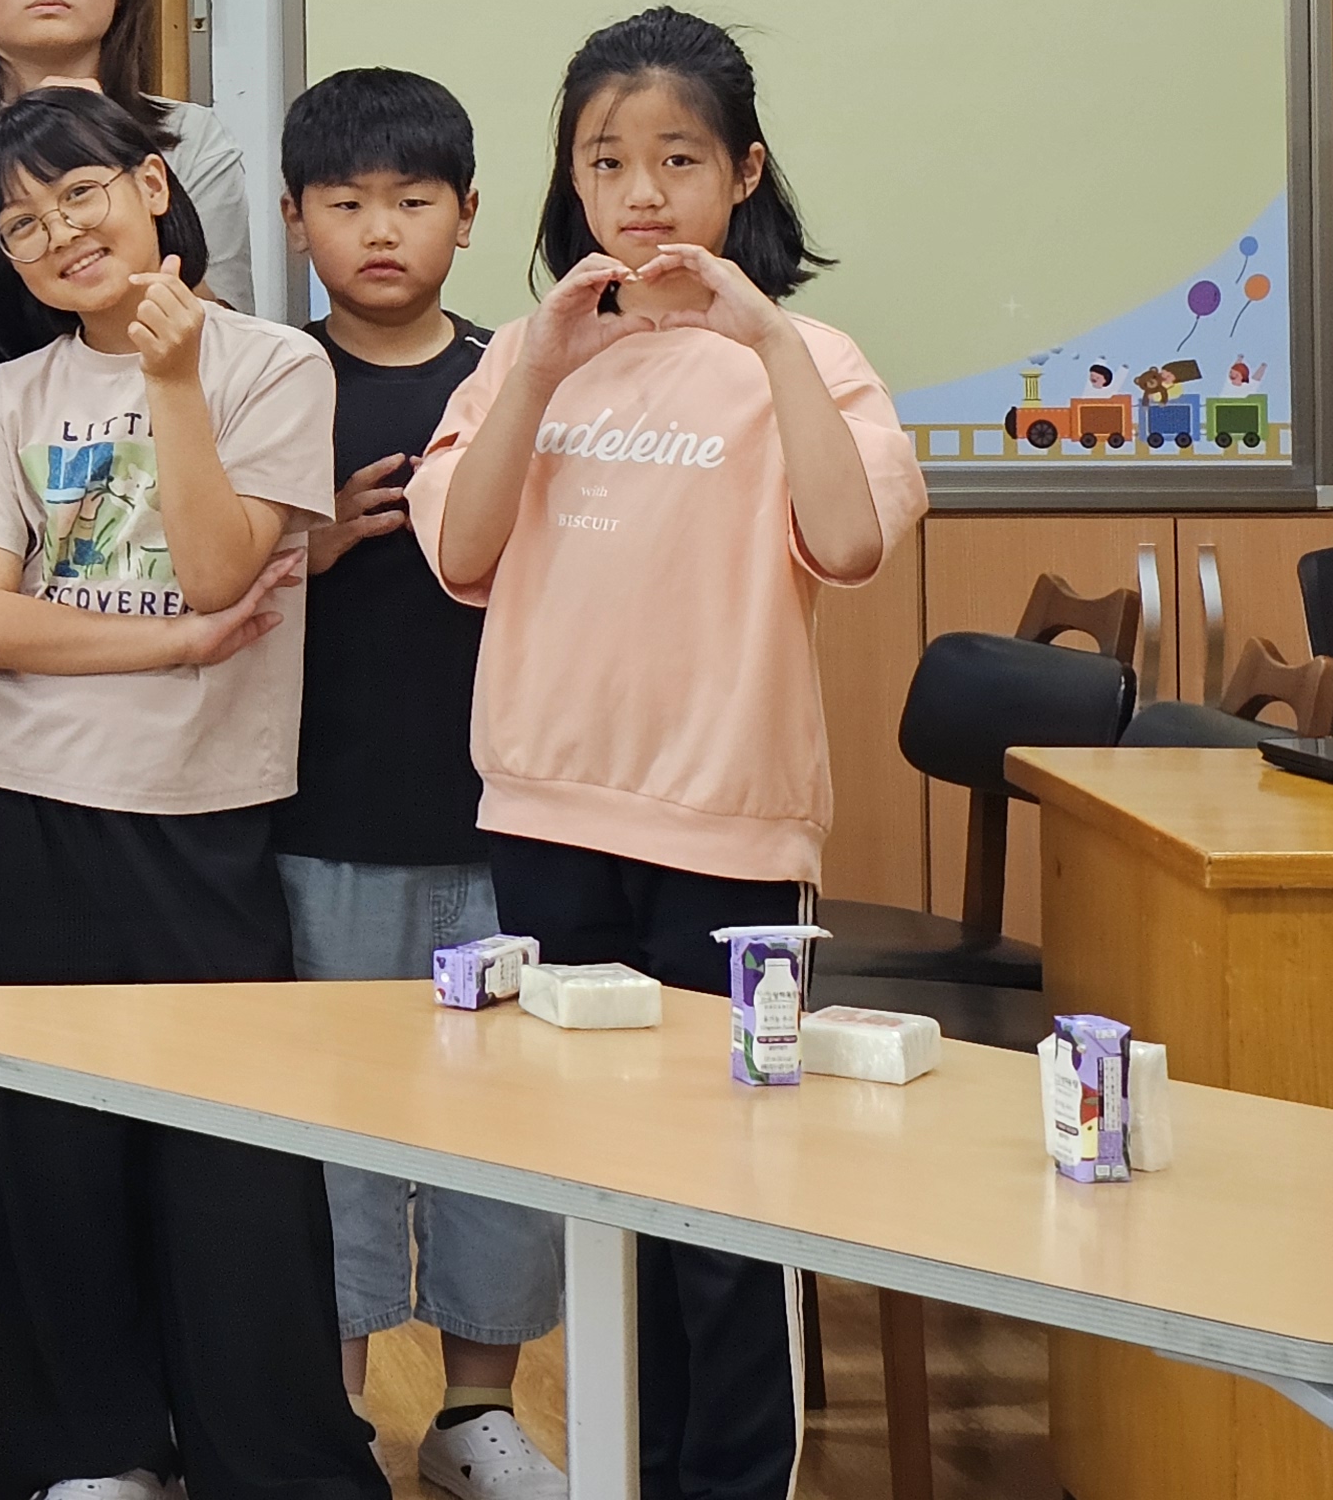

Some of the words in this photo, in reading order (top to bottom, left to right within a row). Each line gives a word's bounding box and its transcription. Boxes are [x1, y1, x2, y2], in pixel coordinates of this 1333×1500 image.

[532, 407, 726, 469] adeleine
[580, 485, 608, 498] with
[558, 513, 621, 532] BISCUIT
